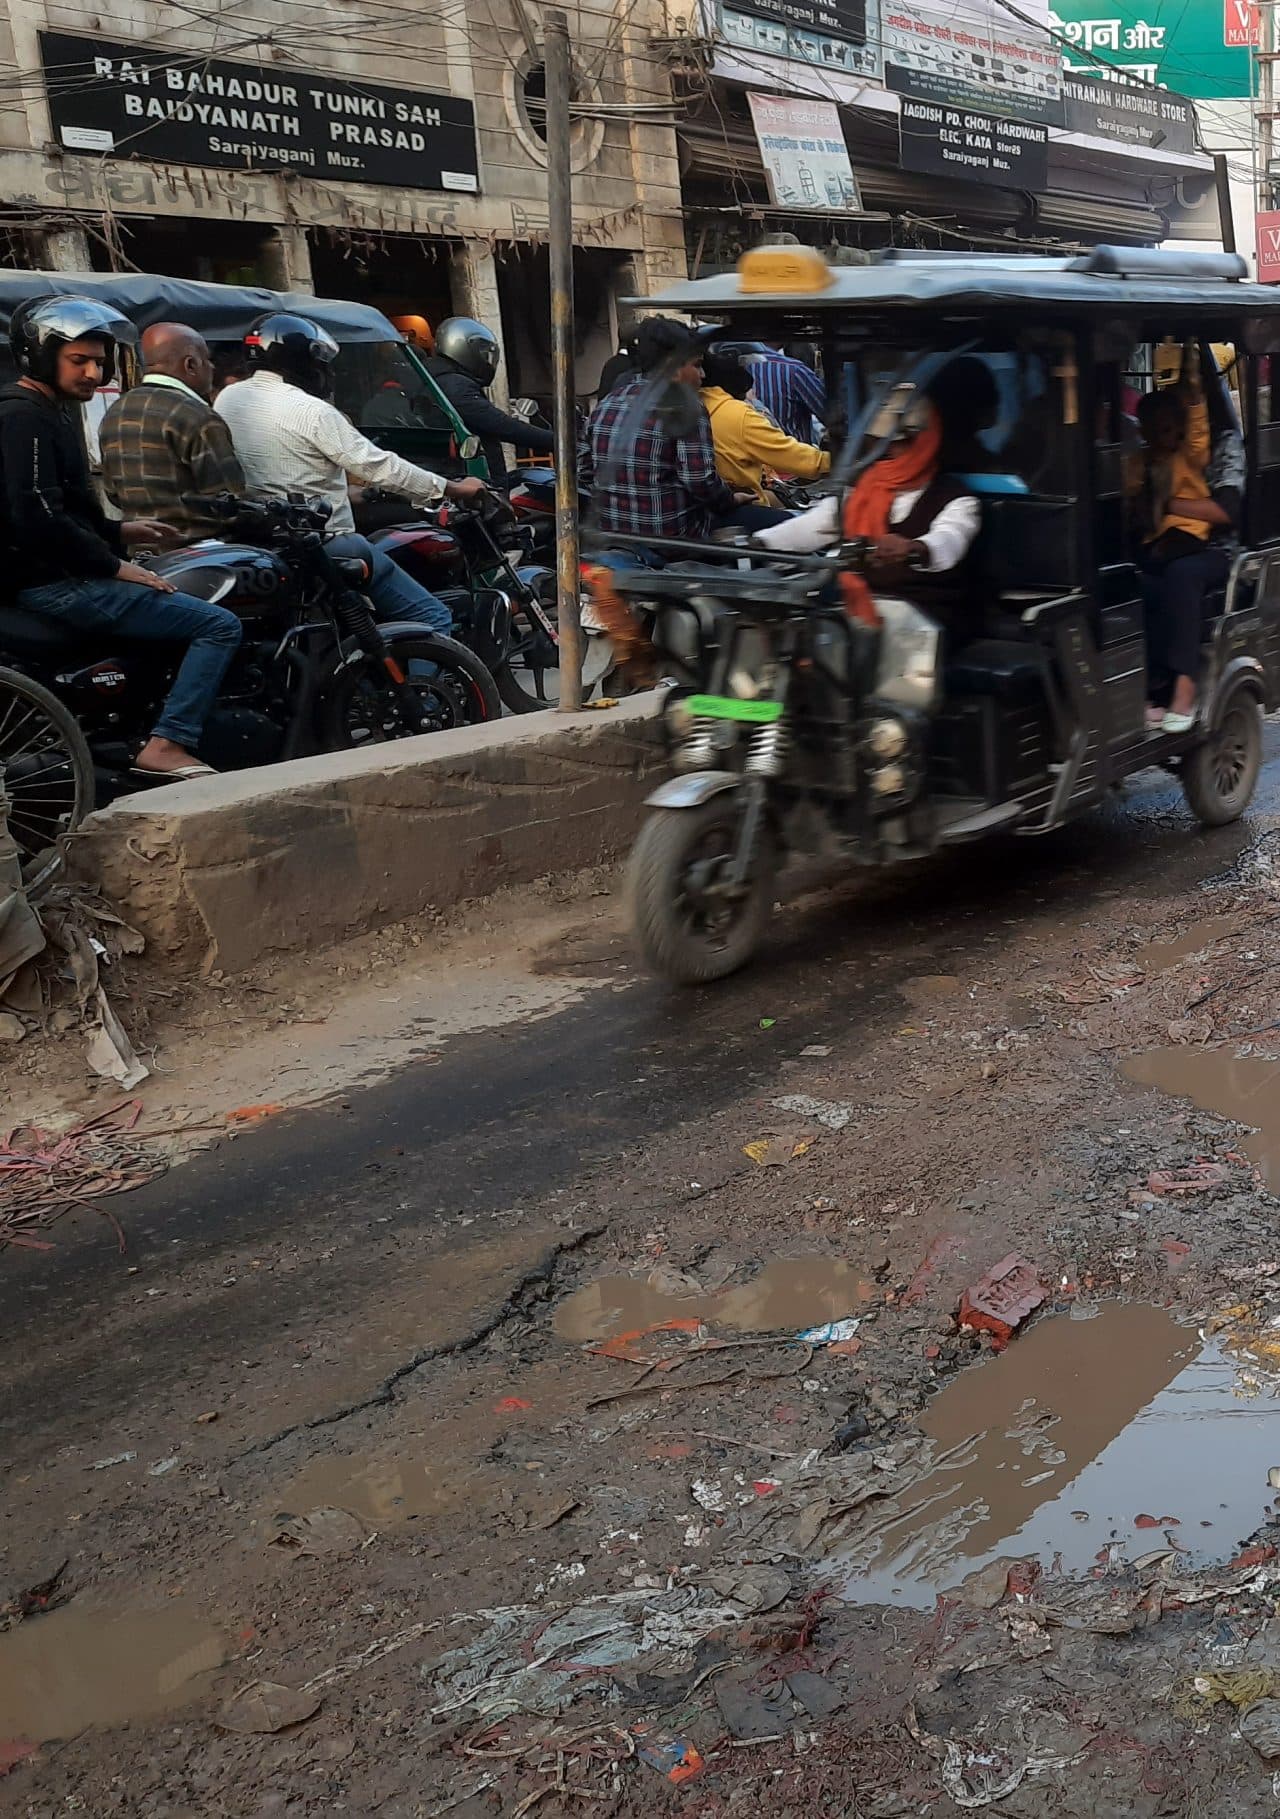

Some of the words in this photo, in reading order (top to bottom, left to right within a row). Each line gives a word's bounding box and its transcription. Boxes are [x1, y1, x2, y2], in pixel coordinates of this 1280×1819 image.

[1123, 20, 1165, 49] और
[94, 56, 150, 85] RAI
[165, 68, 298, 107] BAHADUR
[310, 90, 385, 119] TUNKI
[395, 103, 441, 126] SAH
[1063, 81, 1112, 106] HITRANJAN
[1115, 93, 1158, 116] HARDWARE
[1161, 105, 1187, 122] STORE
[124, 93, 300, 137] BAIDYANATH
[330, 122, 425, 151] PRASAD
[946, 112, 962, 127] PD.
[964, 116, 993, 133] CHOU.
[997, 122, 1046, 143] HARDWARE
[208, 136, 315, 167] Saraiyaganj
[327, 151, 365, 168] Muz.
[939, 129, 961, 145] ELEC.
[966, 134, 992, 150] KATA
[943, 149, 989, 169] Saraiyaganj
[993, 158, 1011, 170] Muz.
